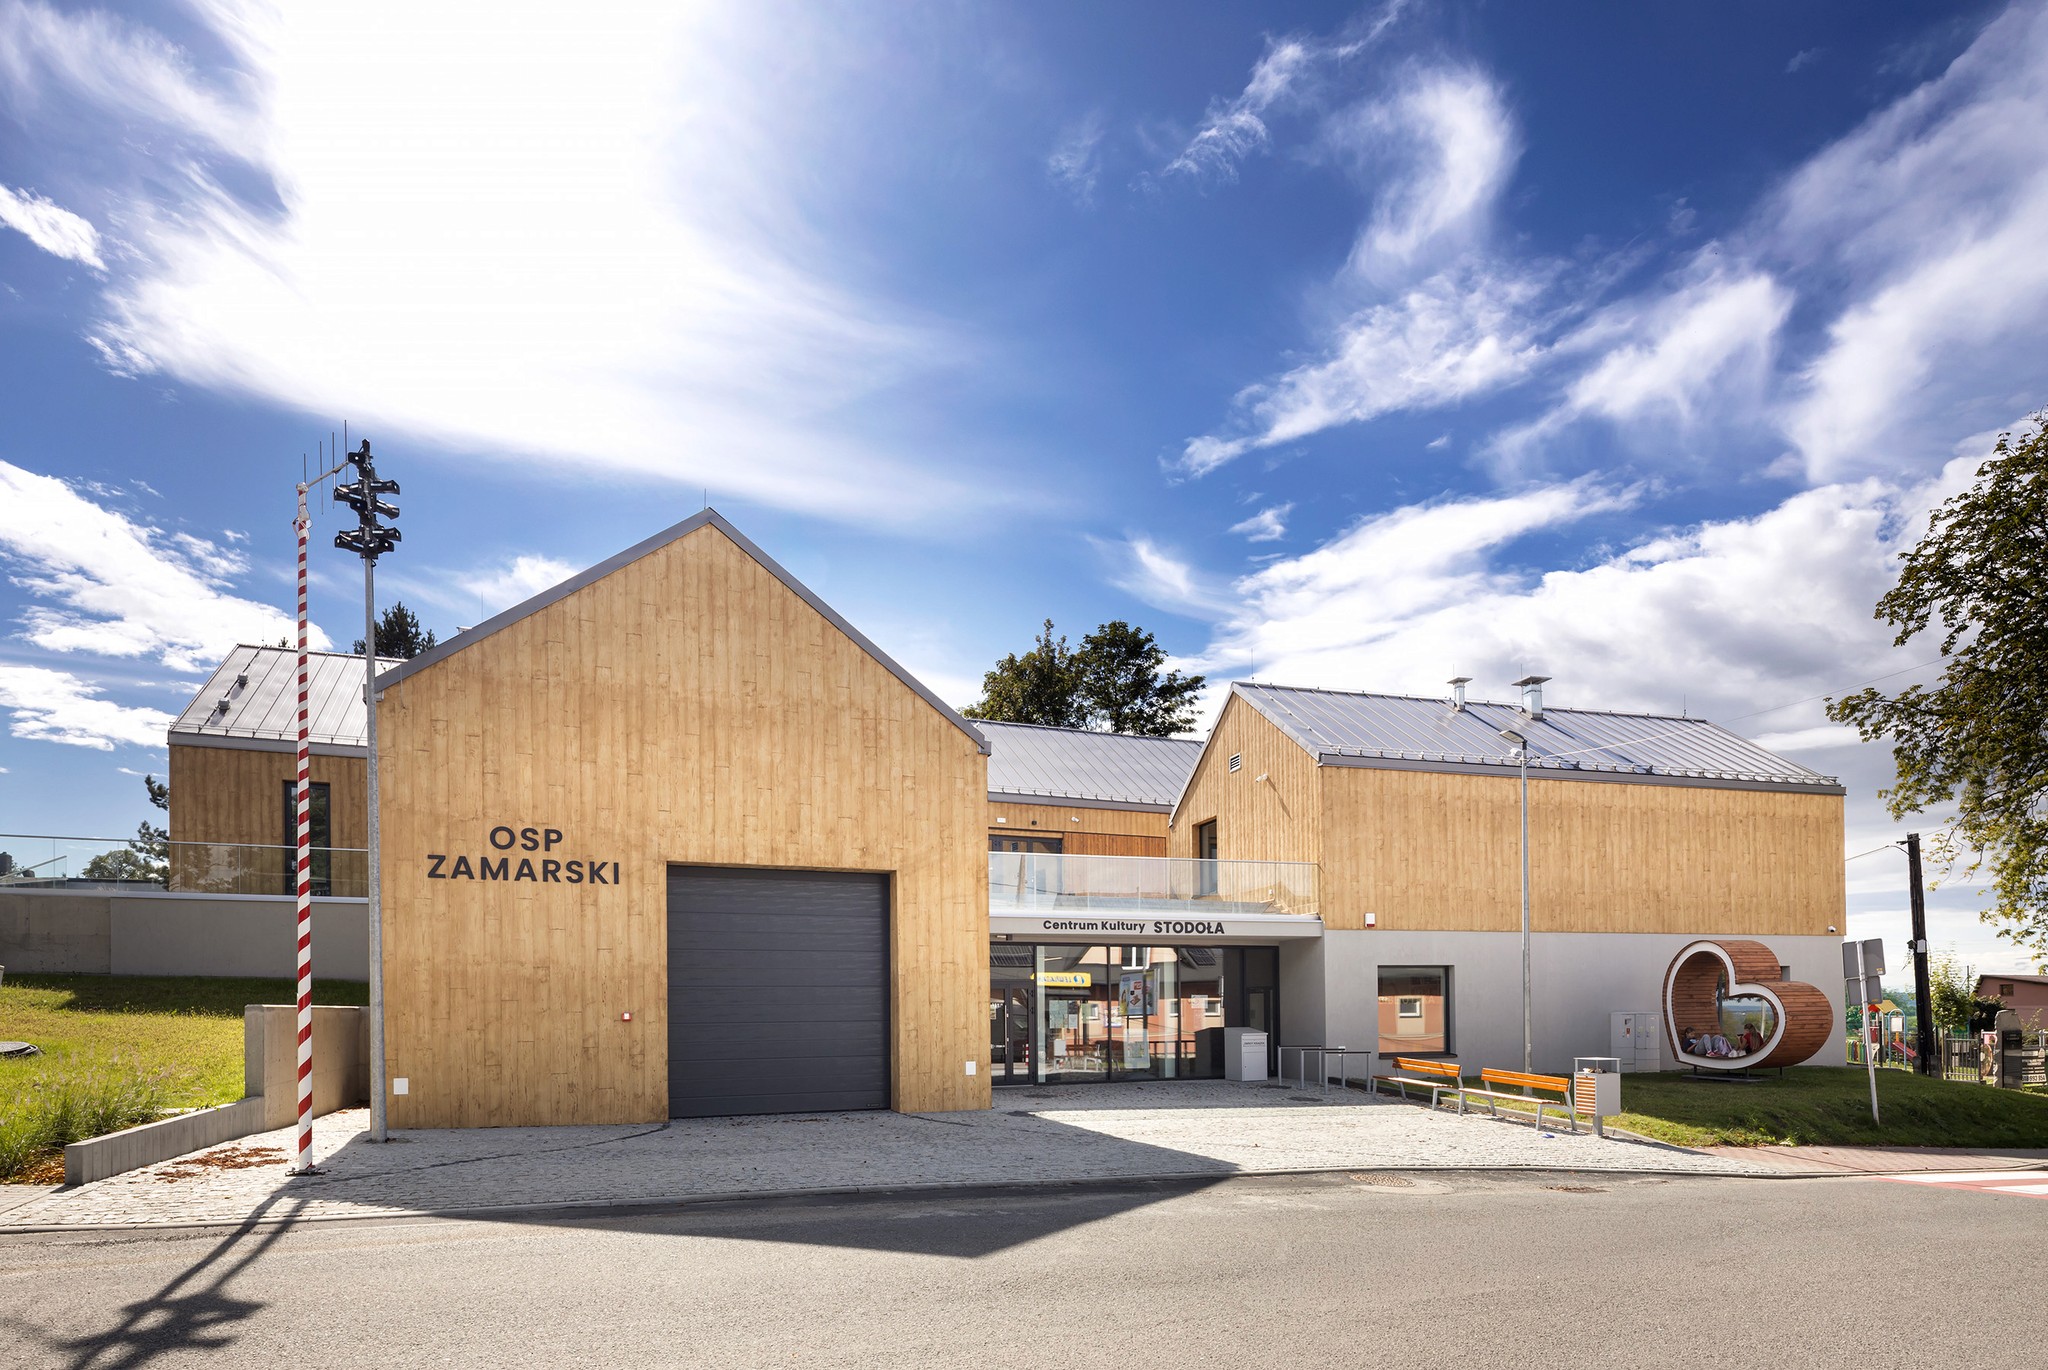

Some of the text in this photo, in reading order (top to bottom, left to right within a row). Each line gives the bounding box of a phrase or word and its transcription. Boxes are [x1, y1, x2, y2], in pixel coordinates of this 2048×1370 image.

[489, 826, 563, 852] OSP
[427, 854, 620, 885] ZAMARSKI
[1043, 920, 1225, 934] Centrum Kultury STODOŁA
